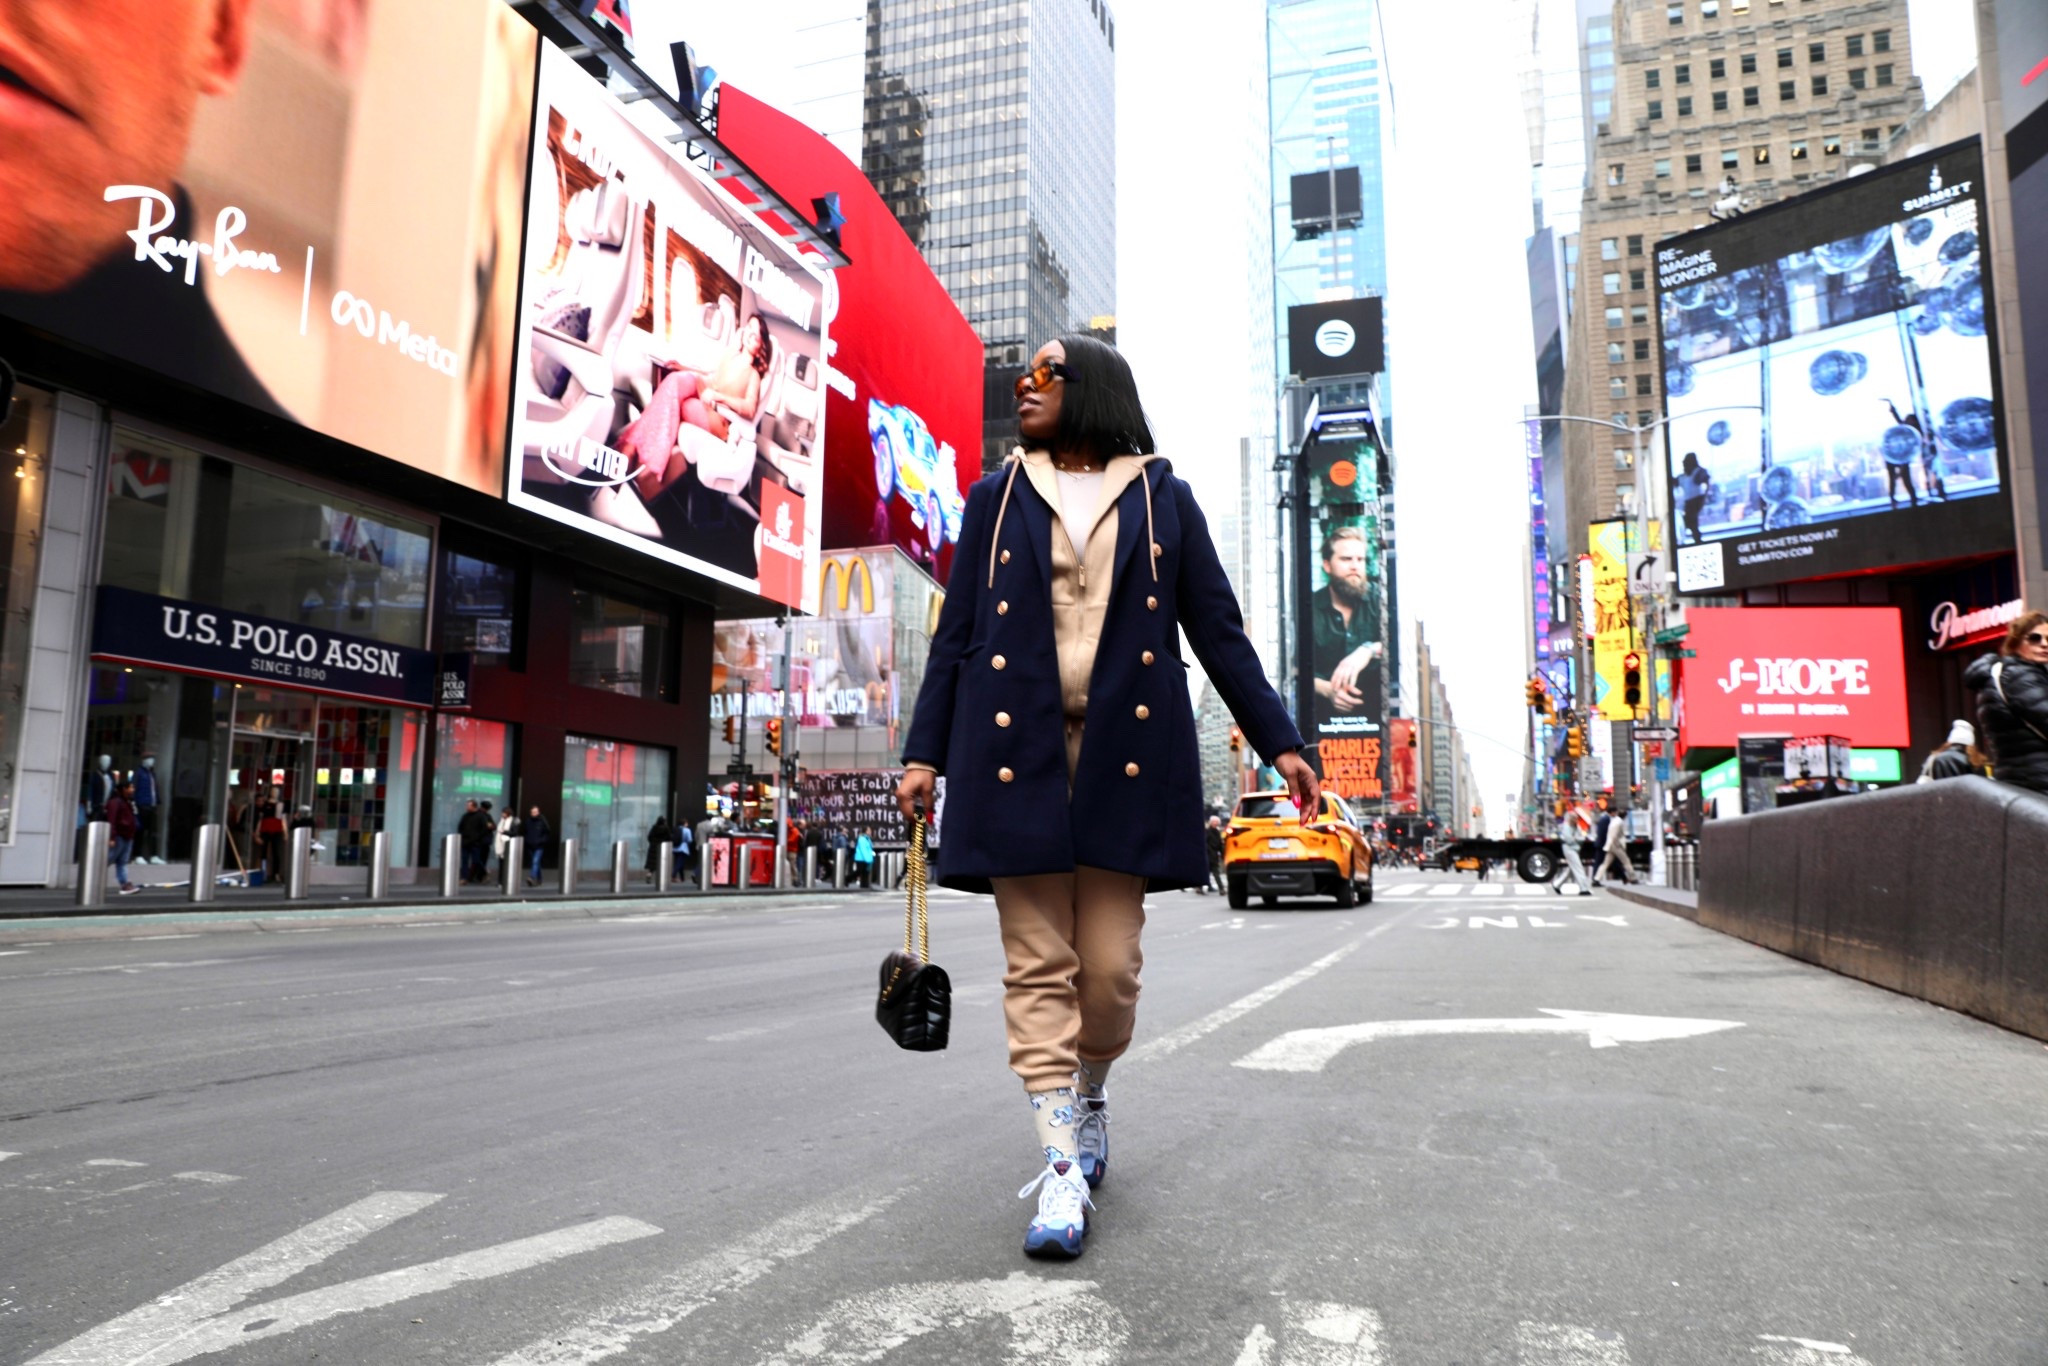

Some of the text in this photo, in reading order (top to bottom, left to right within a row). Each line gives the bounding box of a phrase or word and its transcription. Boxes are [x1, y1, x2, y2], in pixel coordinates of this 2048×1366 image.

[1659, 249, 1712, 276] IMAGINE
[1660, 262, 1718, 288] WONDER
[378, 309, 459, 378] Meta
[1634, 582, 1662, 593] ONLY
[162, 605, 404, 679] U.S. POLO ASSN.
[251, 658, 327, 681] SINCE 1890
[442, 680, 466, 690] POLO
[1318, 737, 1381, 760] CHARLES
[1321, 758, 1379, 779] WESLEY
[827, 779, 838, 791] IF
[841, 778, 859, 791] WE
[829, 811, 852, 823] WAS
[855, 808, 904, 824] DIRTIER
